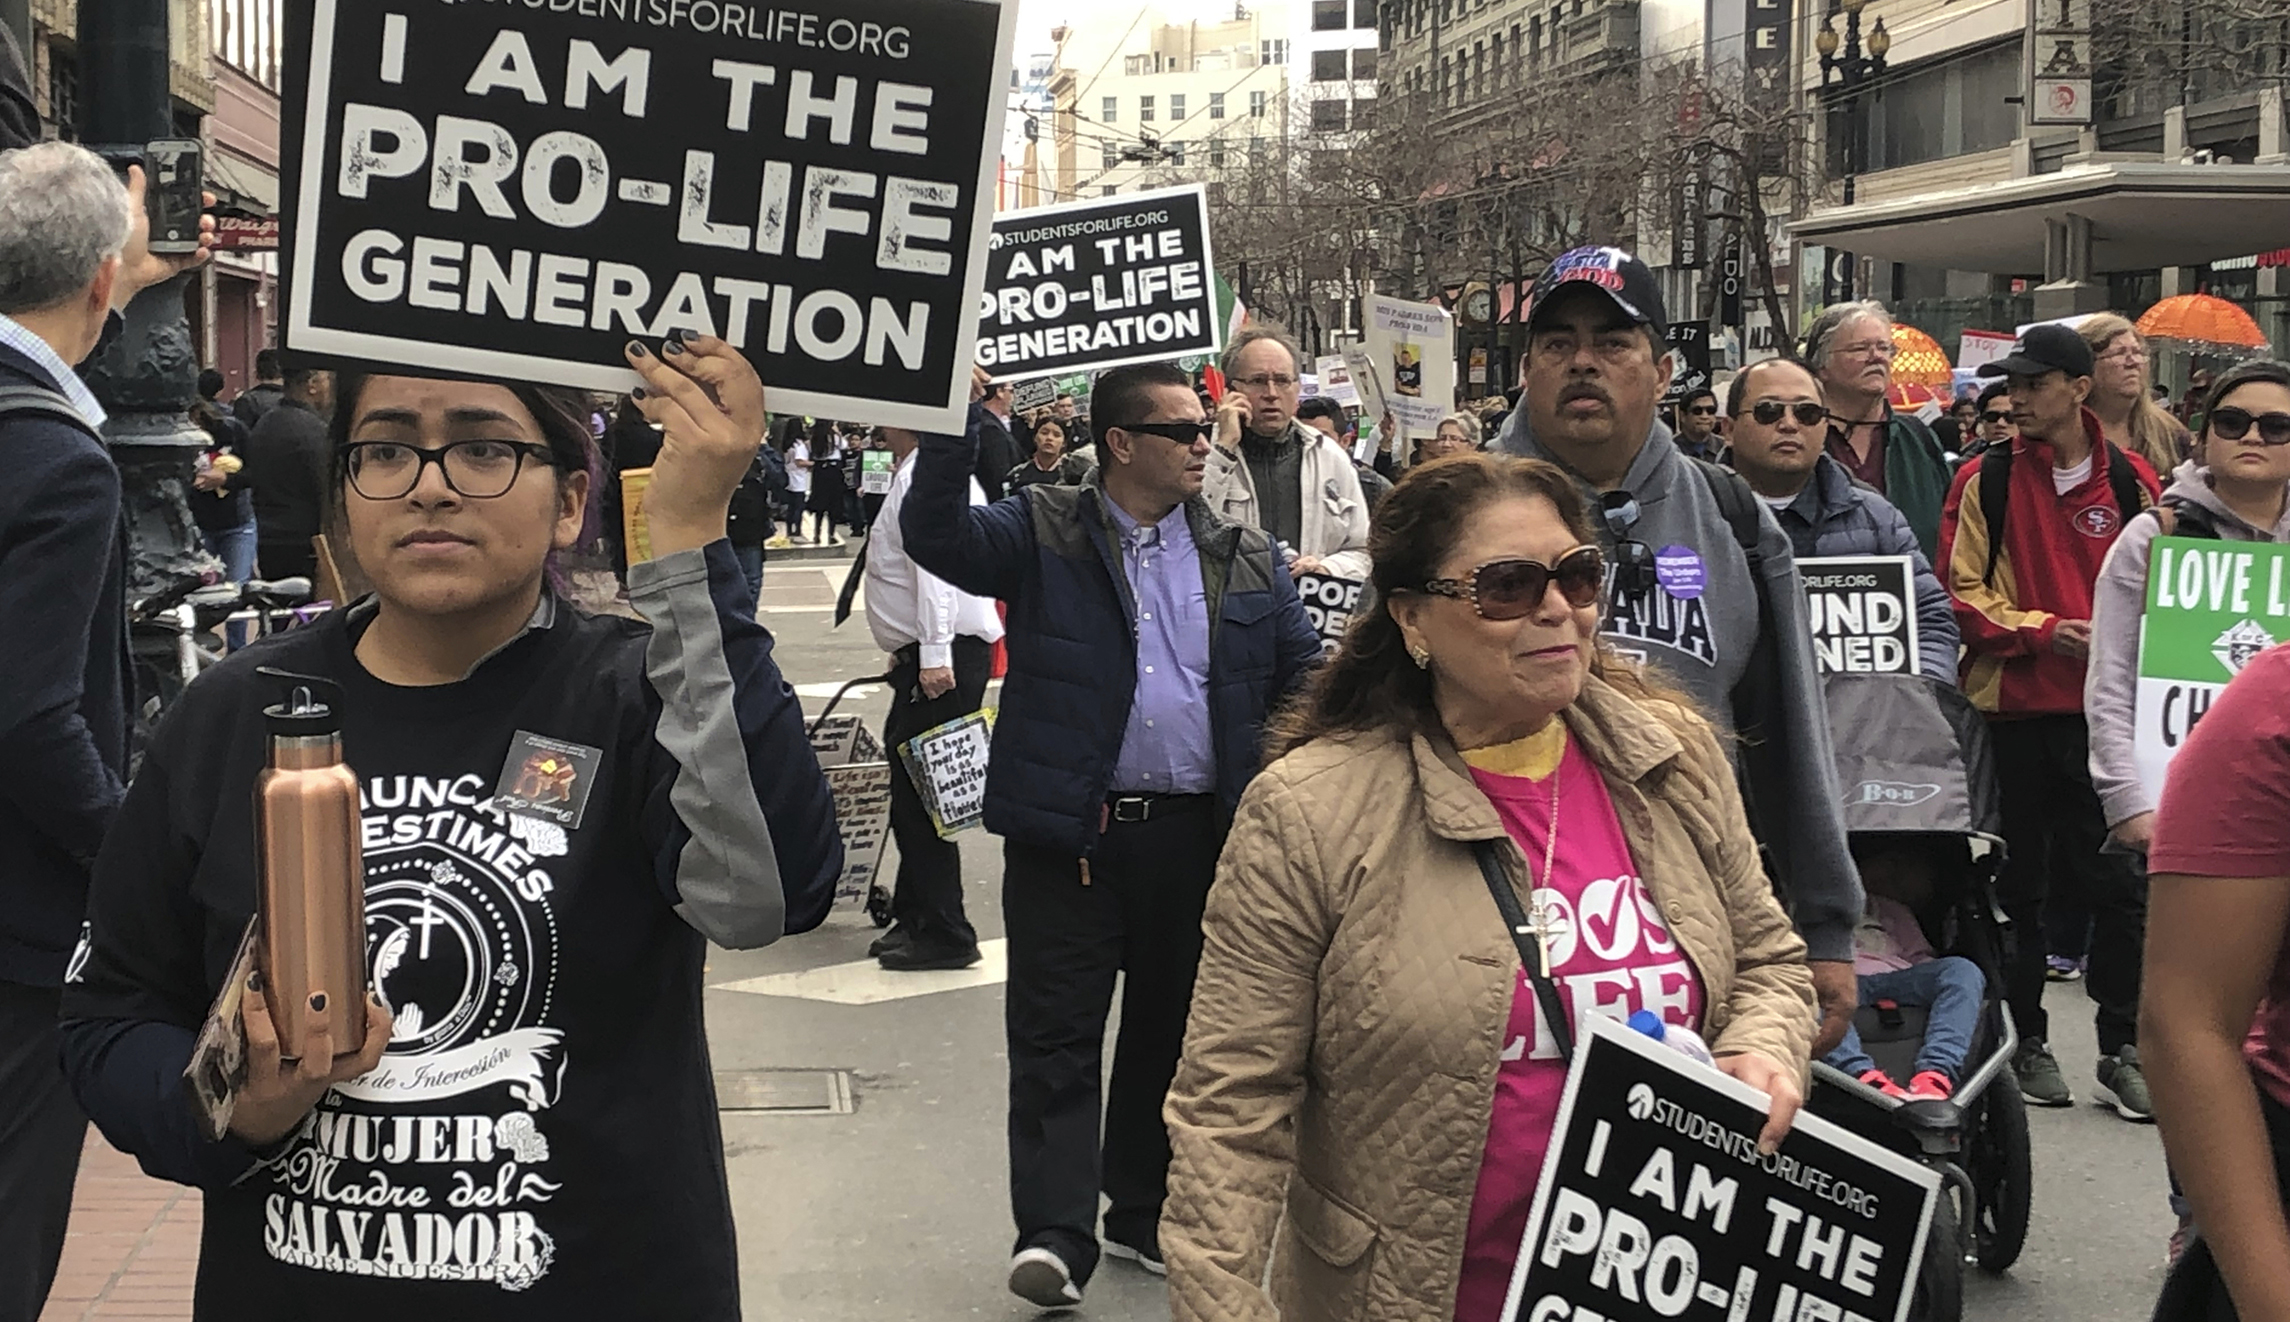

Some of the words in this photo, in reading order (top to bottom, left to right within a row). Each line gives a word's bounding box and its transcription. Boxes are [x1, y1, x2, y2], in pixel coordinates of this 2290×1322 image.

[484, 0, 910, 59] ENTSFORLIFE.ORG
[380, 13, 408, 84] I
[465, 30, 651, 118] AM
[712, 59, 933, 155] THE
[339, 103, 958, 276] PRO-LIFE
[1005, 210, 1168, 246] STUDENTSFORLIFE.ORG
[1006, 244, 1075, 280] AM
[1095, 229, 1184, 266] THE
[342, 229, 931, 371] GENERATION
[980, 261, 1203, 326] PRO-LIFE
[975, 309, 1201, 366] GENERATION
[2157, 548, 2253, 613] LOVE
[2267, 555, 2290, 616] L
[929, 742, 939, 756] I
[942, 733, 971, 750] hope
[930, 752, 953, 774] your
[955, 744, 977, 760] day
[944, 764, 957, 775] is
[361, 773, 506, 827] UNCA
[952, 785, 968, 798] as
[968, 782, 978, 793] a
[362, 809, 554, 903] ESTIMES
[1527, 874, 1676, 969] OOS
[371, 1069, 396, 1090] de
[399, 1046, 512, 1090] Intercesión
[316, 1111, 496, 1163] MUJER
[290, 1148, 432, 1208] Madre
[446, 1161, 518, 1208] del
[265, 1192, 537, 1269] SALVADOR
[1584, 1118, 1612, 1178] I
[1630, 1147, 1740, 1235] AM
[1765, 1196, 1884, 1298] THE
[1541, 1187, 1875, 1322] PRO-L
